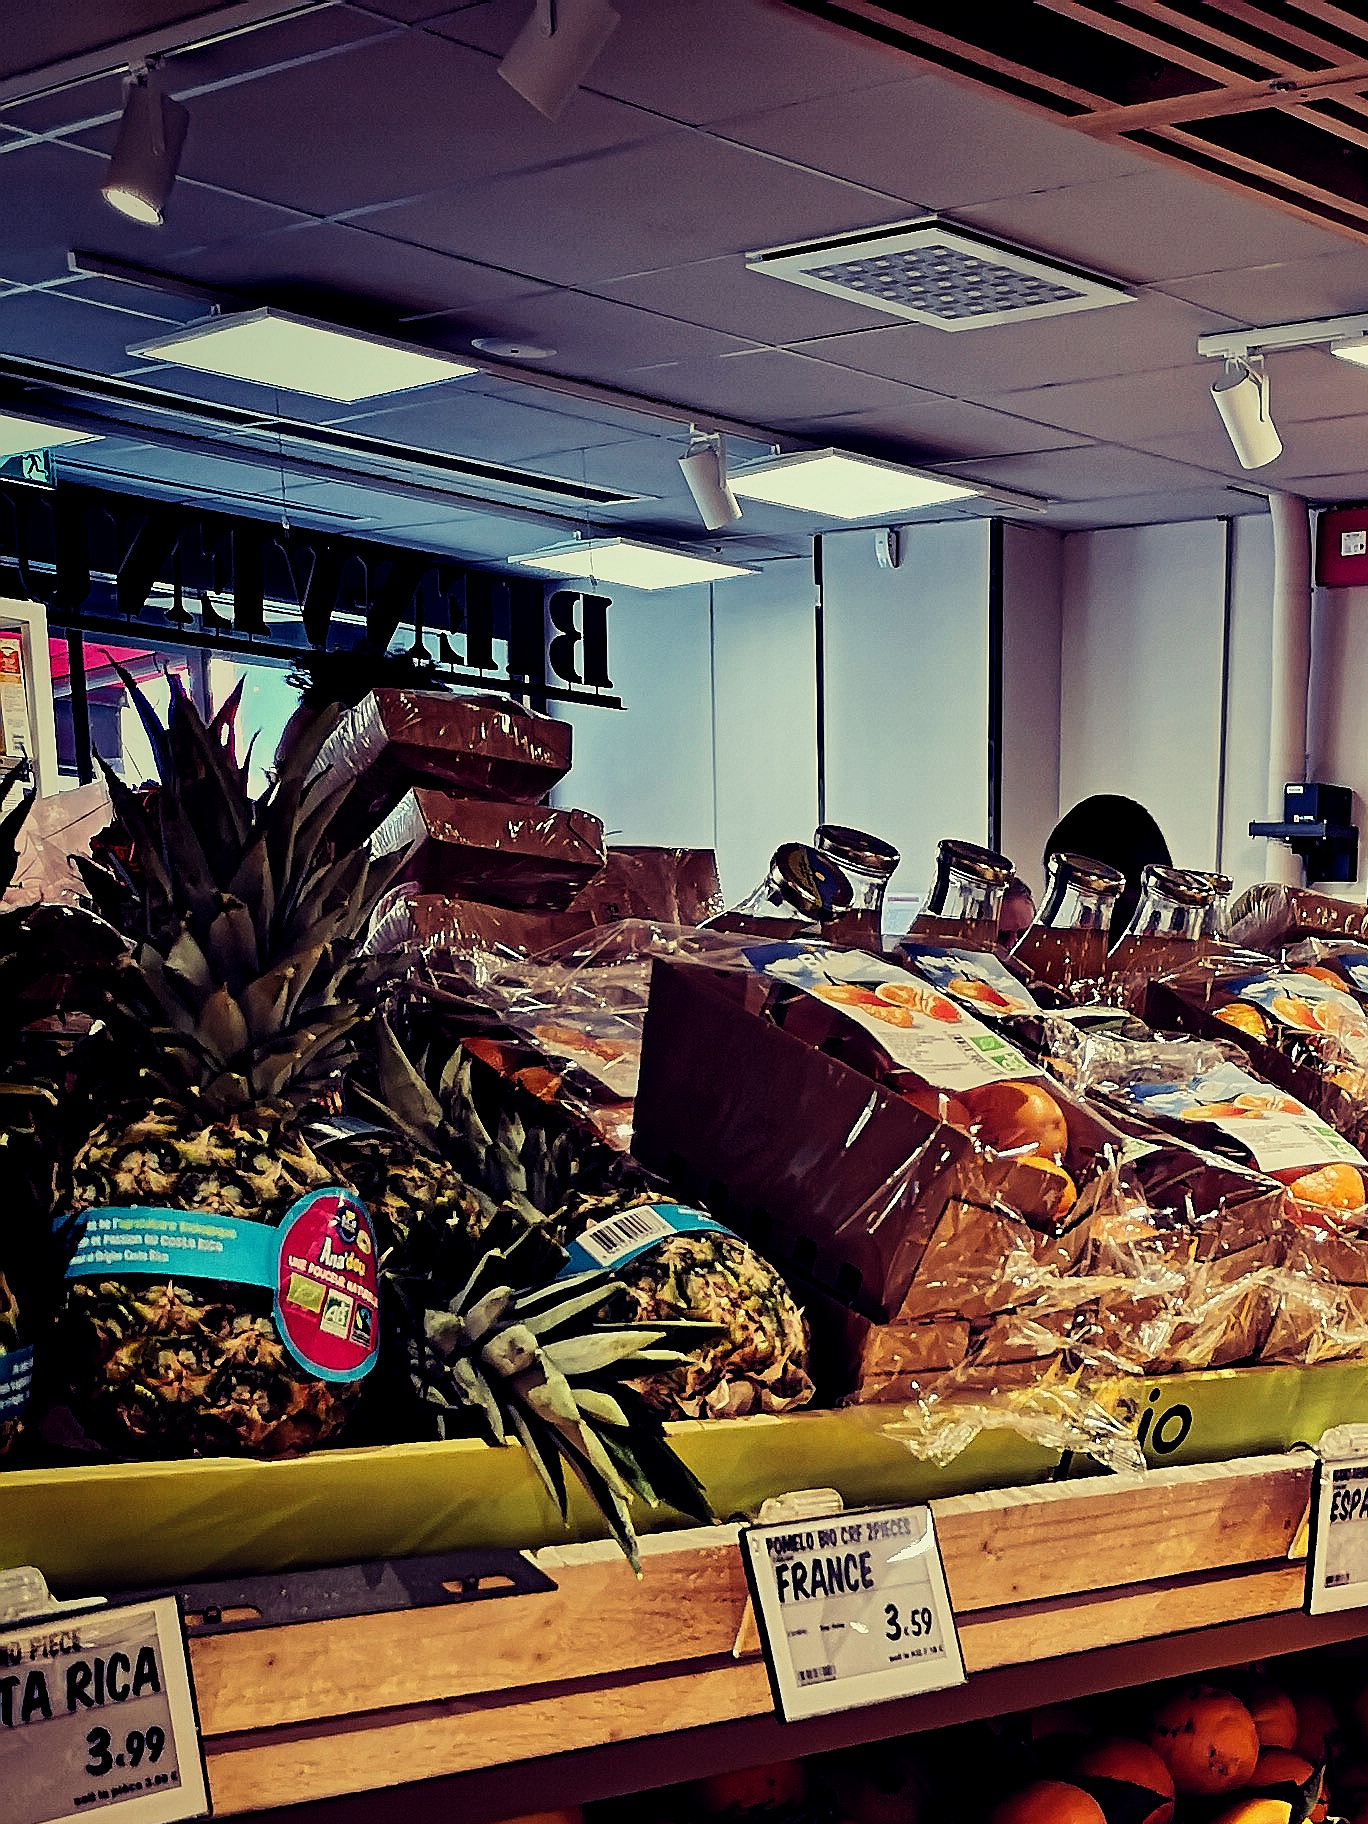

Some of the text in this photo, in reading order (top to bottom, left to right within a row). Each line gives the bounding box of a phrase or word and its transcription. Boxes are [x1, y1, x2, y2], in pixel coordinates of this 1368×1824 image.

[775, 1550, 875, 1604] FRANCE
[0, 1646, 161, 1728] TA RICA
